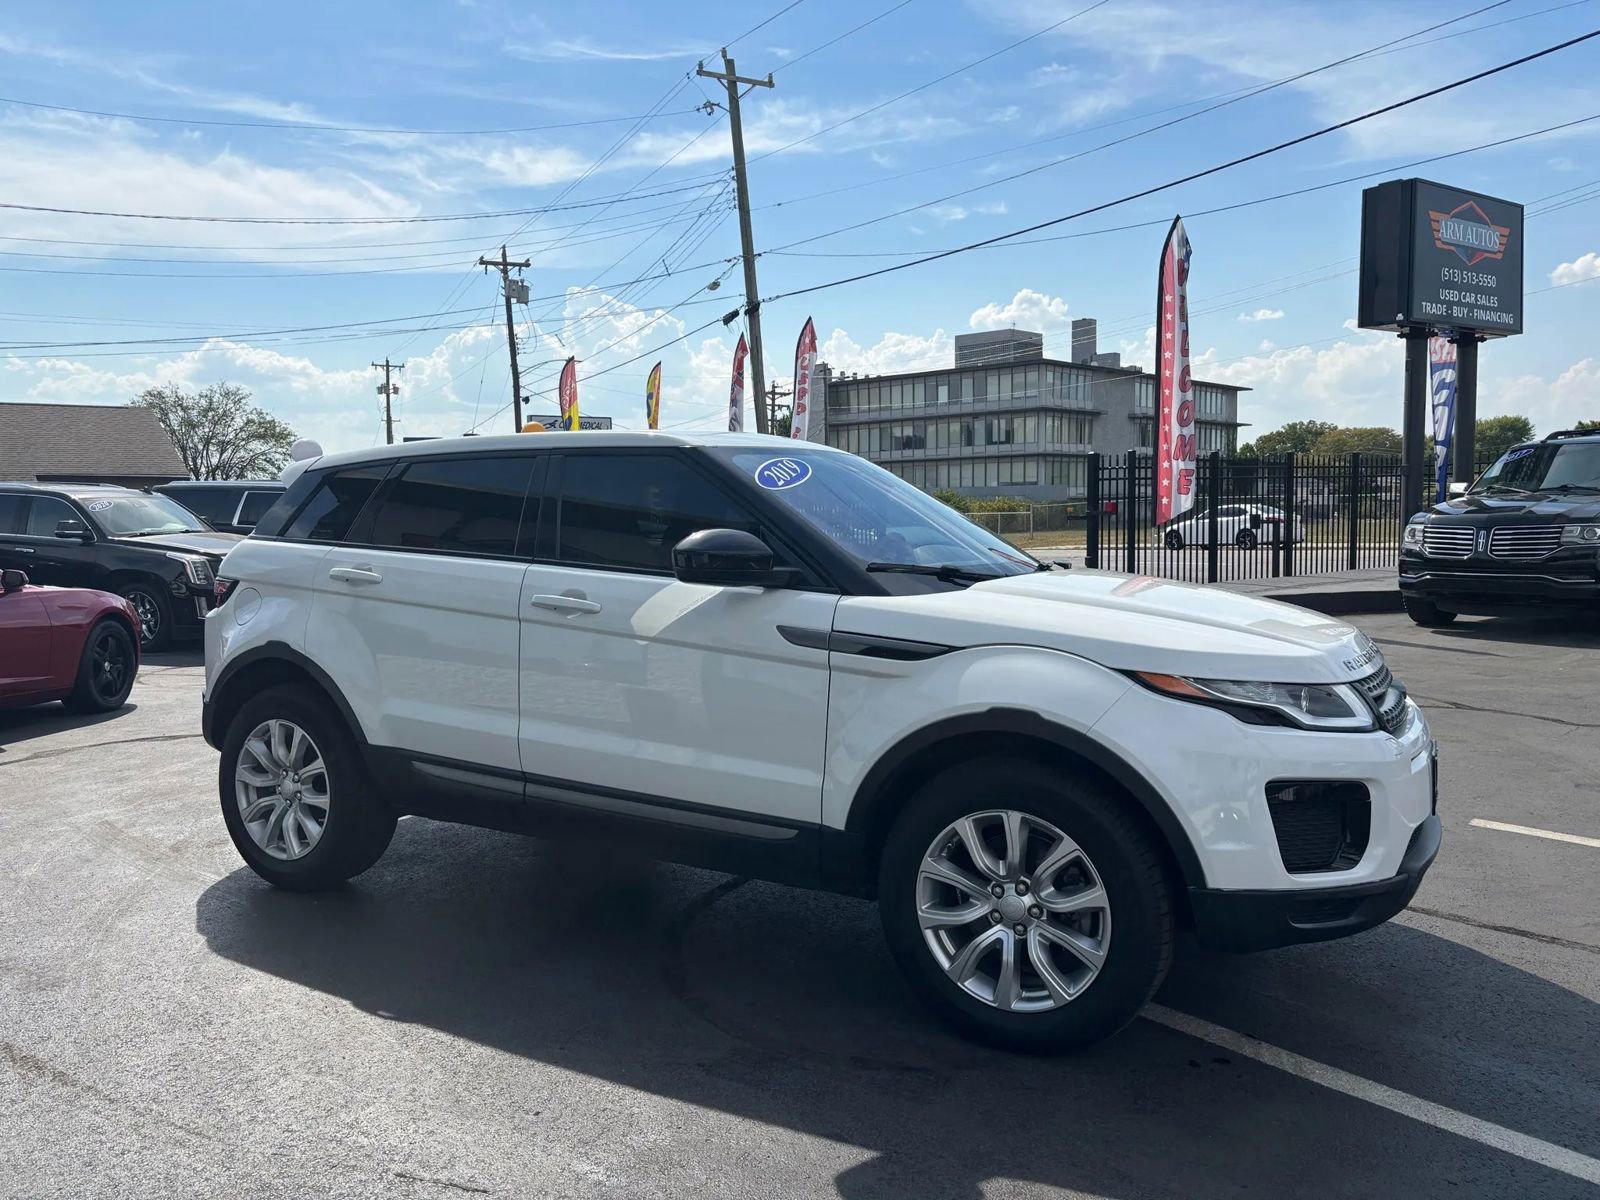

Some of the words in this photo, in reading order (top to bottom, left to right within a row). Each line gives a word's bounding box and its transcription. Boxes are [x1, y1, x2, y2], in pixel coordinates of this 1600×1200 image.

[1439, 220, 1464, 241] ARM
[1465, 226, 1500, 249] AUTOS
[1441, 267, 1461, 284] (513)
[1463, 271, 1497, 287] 513-5550
[1440, 288, 1459, 301] USED
[1461, 291, 1476, 304] CAR
[1477, 294, 1498, 307] SALES
[1421, 302, 1447, 315] TRADE
[1452, 306, 1468, 318] BUY
[1473, 308, 1514, 324] FINANCING
[764, 459, 801, 486] 2019
